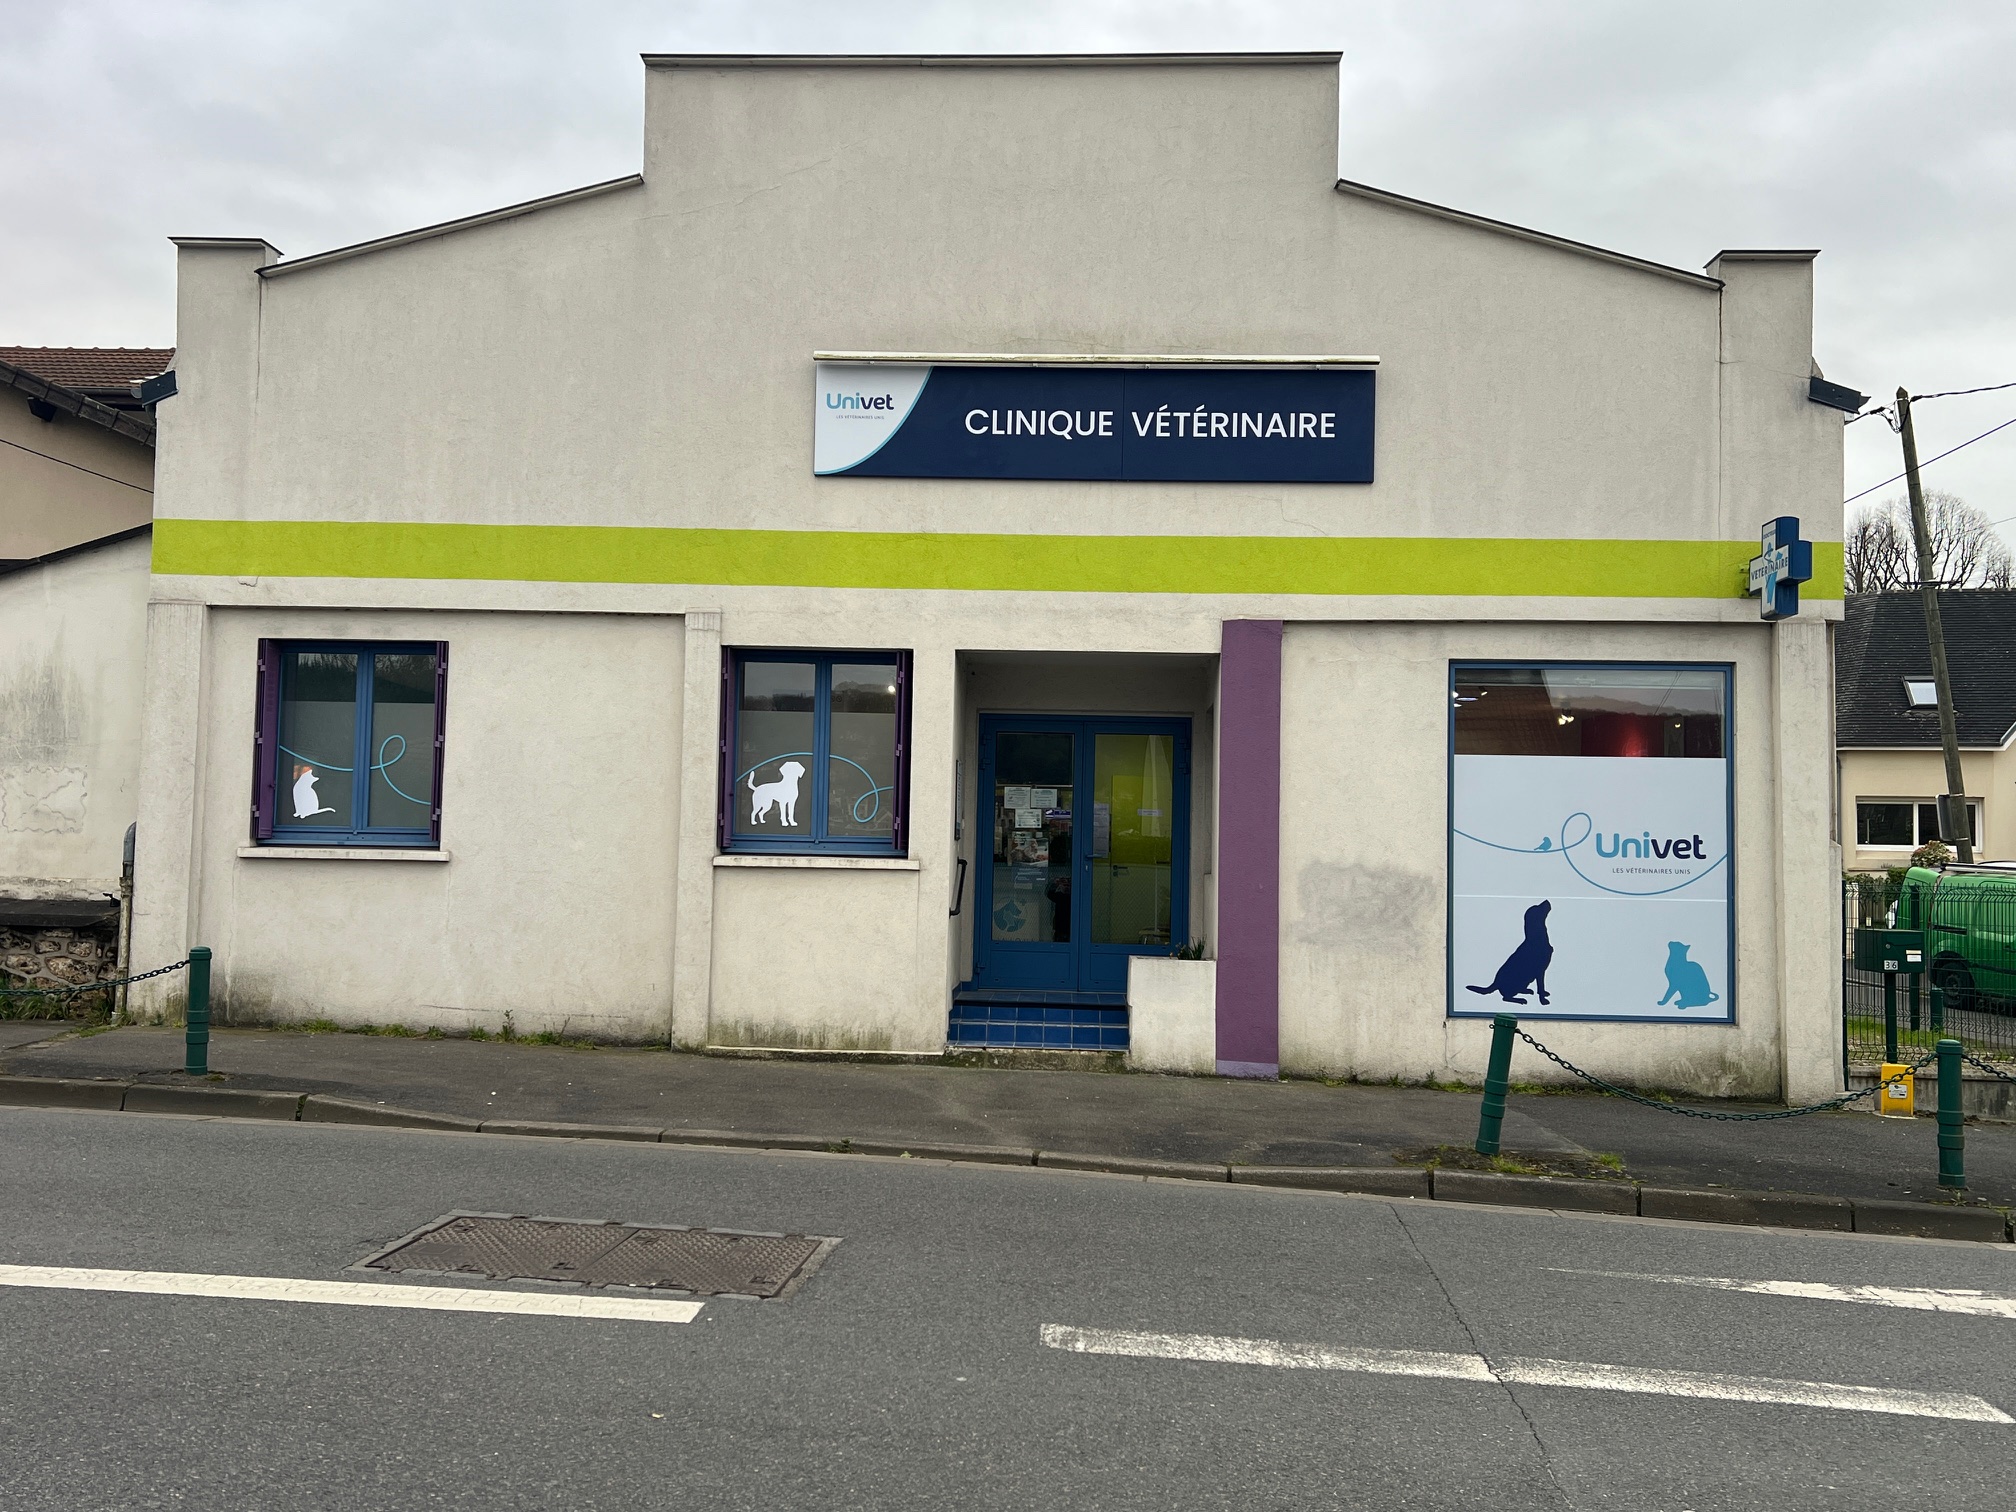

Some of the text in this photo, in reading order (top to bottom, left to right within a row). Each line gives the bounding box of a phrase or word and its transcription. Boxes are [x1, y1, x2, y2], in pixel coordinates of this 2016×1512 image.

[826, 392, 895, 410] Univet
[965, 404, 1336, 440] CLINIQUE VÉTÉRINAIRE
[1595, 831, 1707, 860] Univet
[1626, 867, 1673, 875] VÉTÉRINAIRES
[1885, 961, 1897, 969] 36
